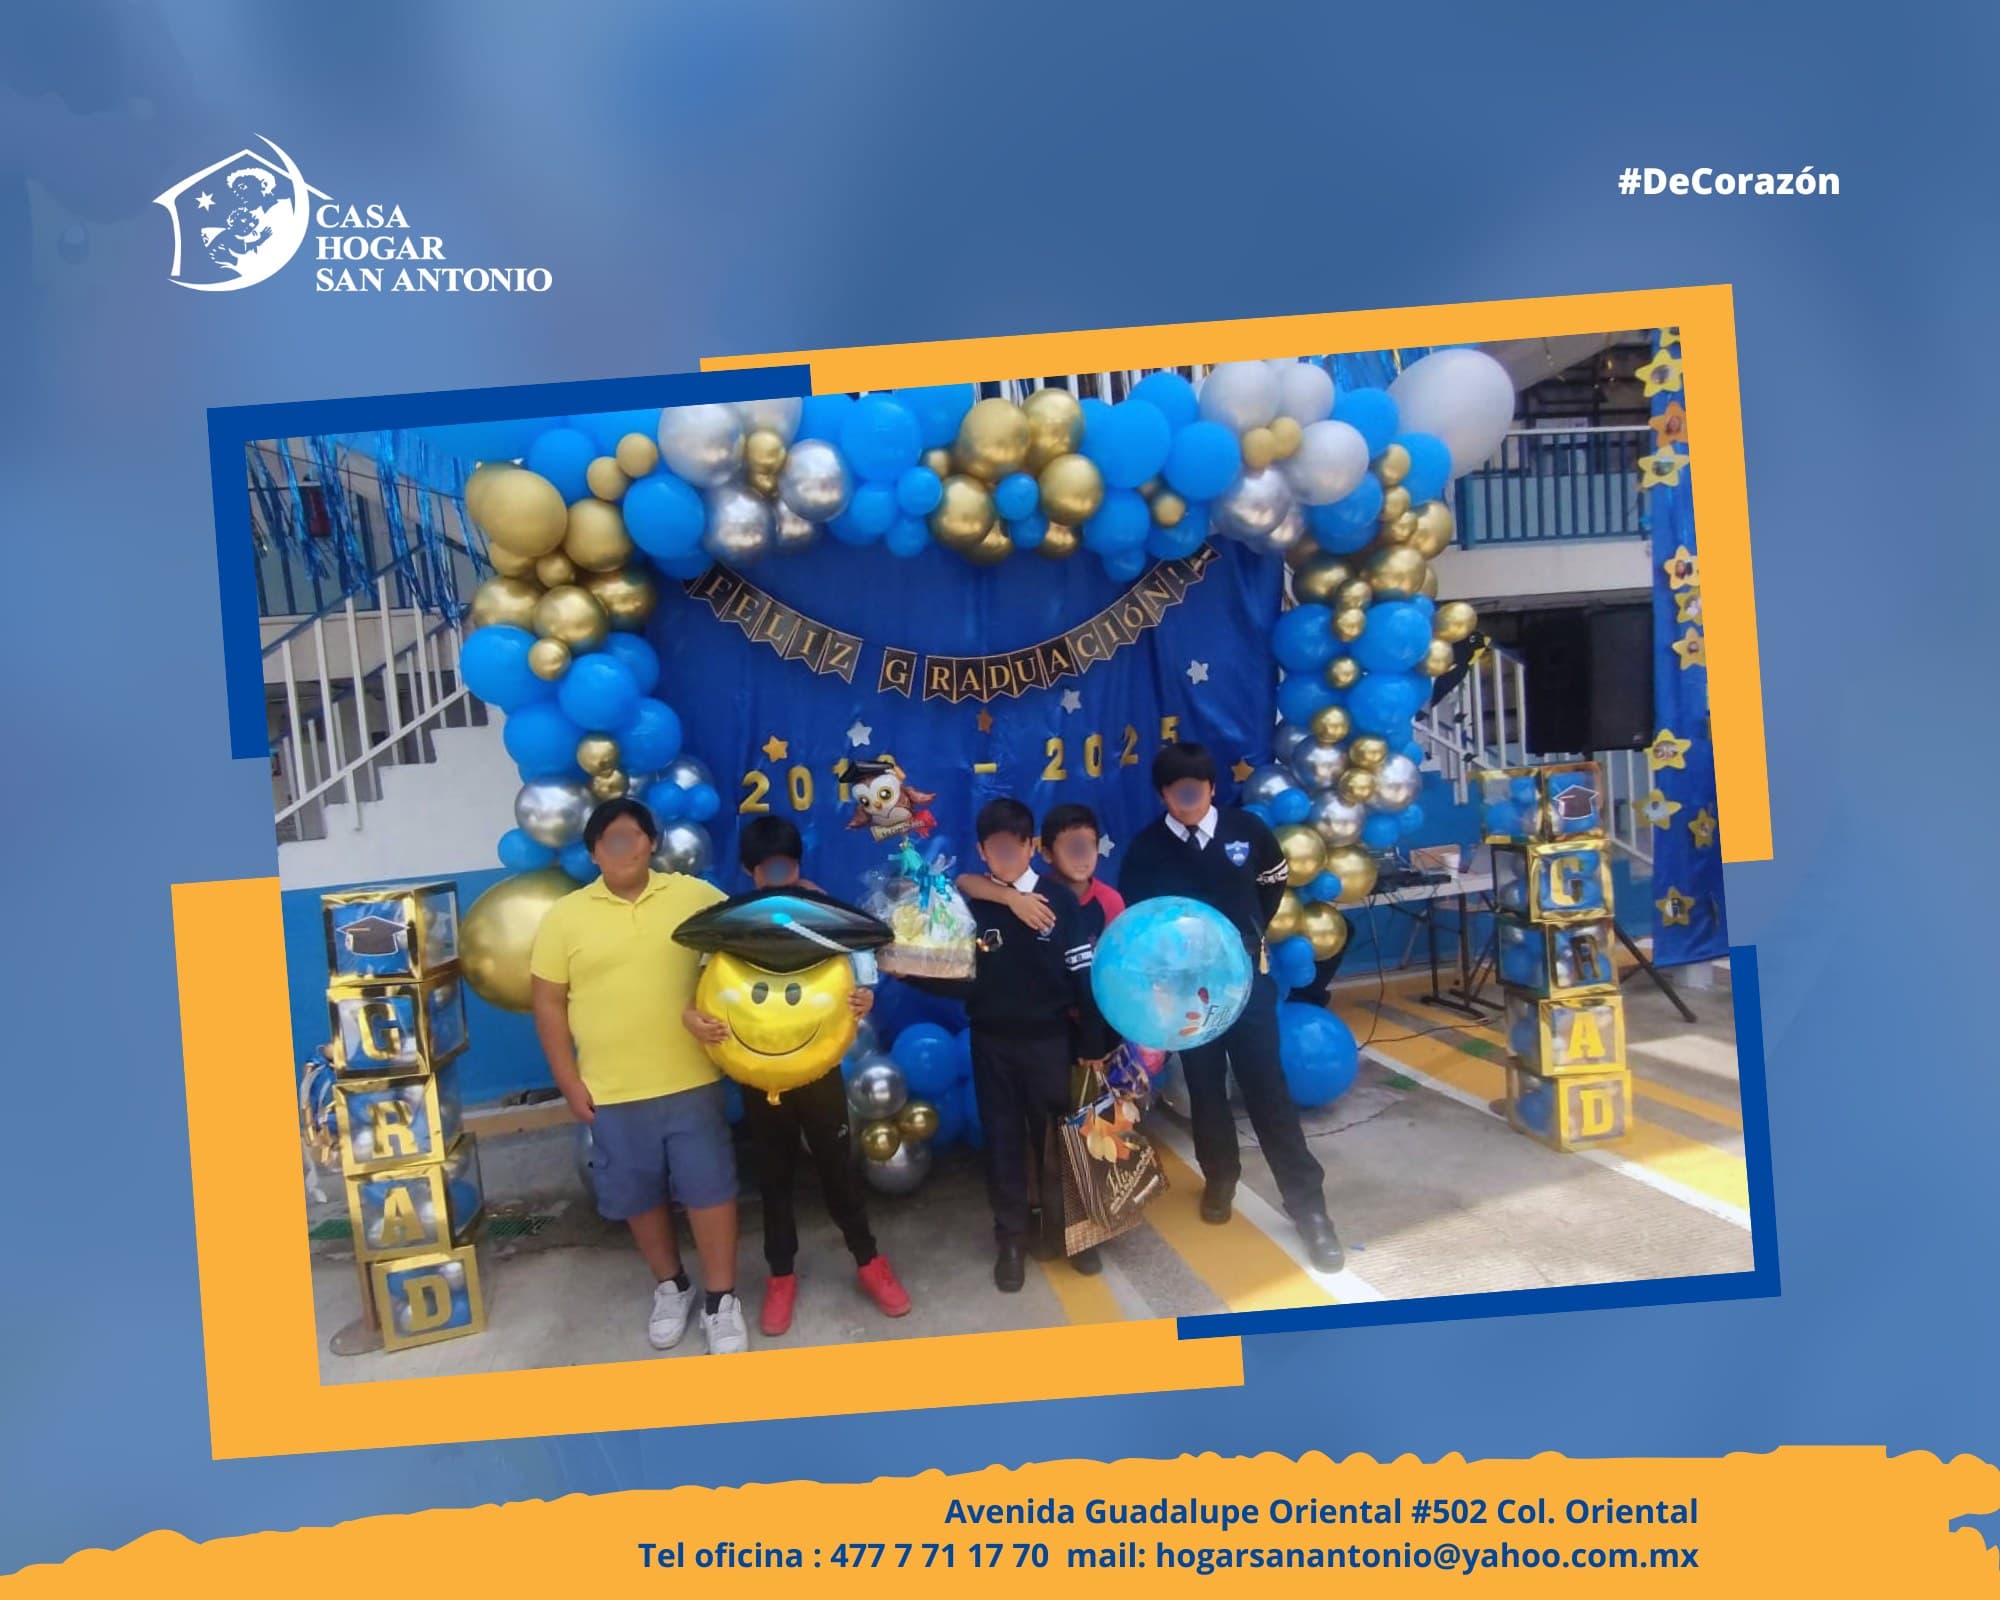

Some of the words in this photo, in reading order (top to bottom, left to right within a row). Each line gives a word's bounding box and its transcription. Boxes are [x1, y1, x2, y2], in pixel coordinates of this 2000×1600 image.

[705, 575, 853, 669] FELIZ
[739, 753, 898, 814] 201
[1041, 715, 1179, 781] 2025
